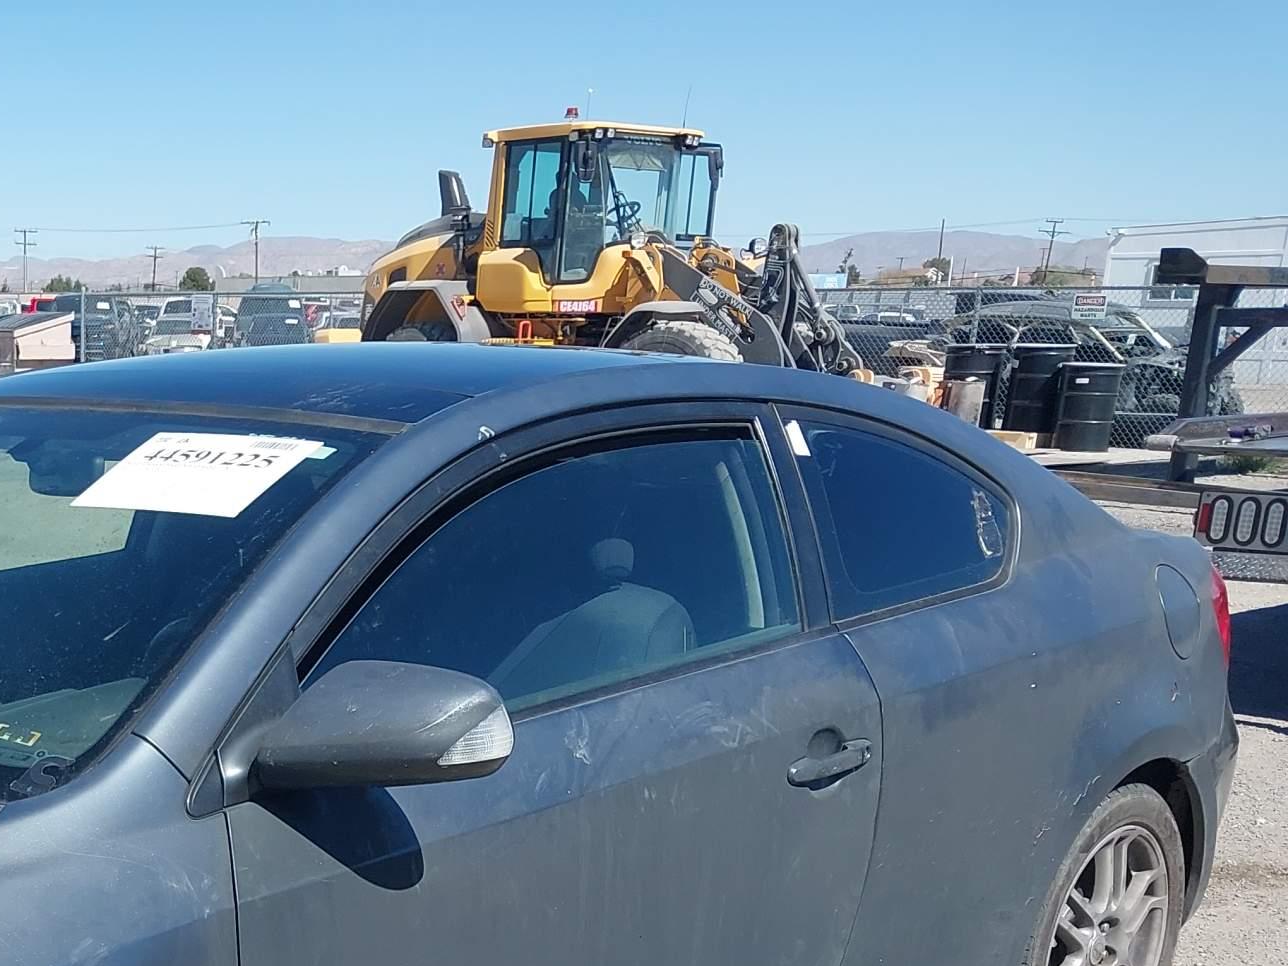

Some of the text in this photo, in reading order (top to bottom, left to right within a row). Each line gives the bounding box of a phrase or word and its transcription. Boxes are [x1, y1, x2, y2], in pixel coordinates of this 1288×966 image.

[699, 280, 751, 315] DO NOT WALK
[714, 319, 734, 337] MAST
[143, 449, 280, 468] 44591225
